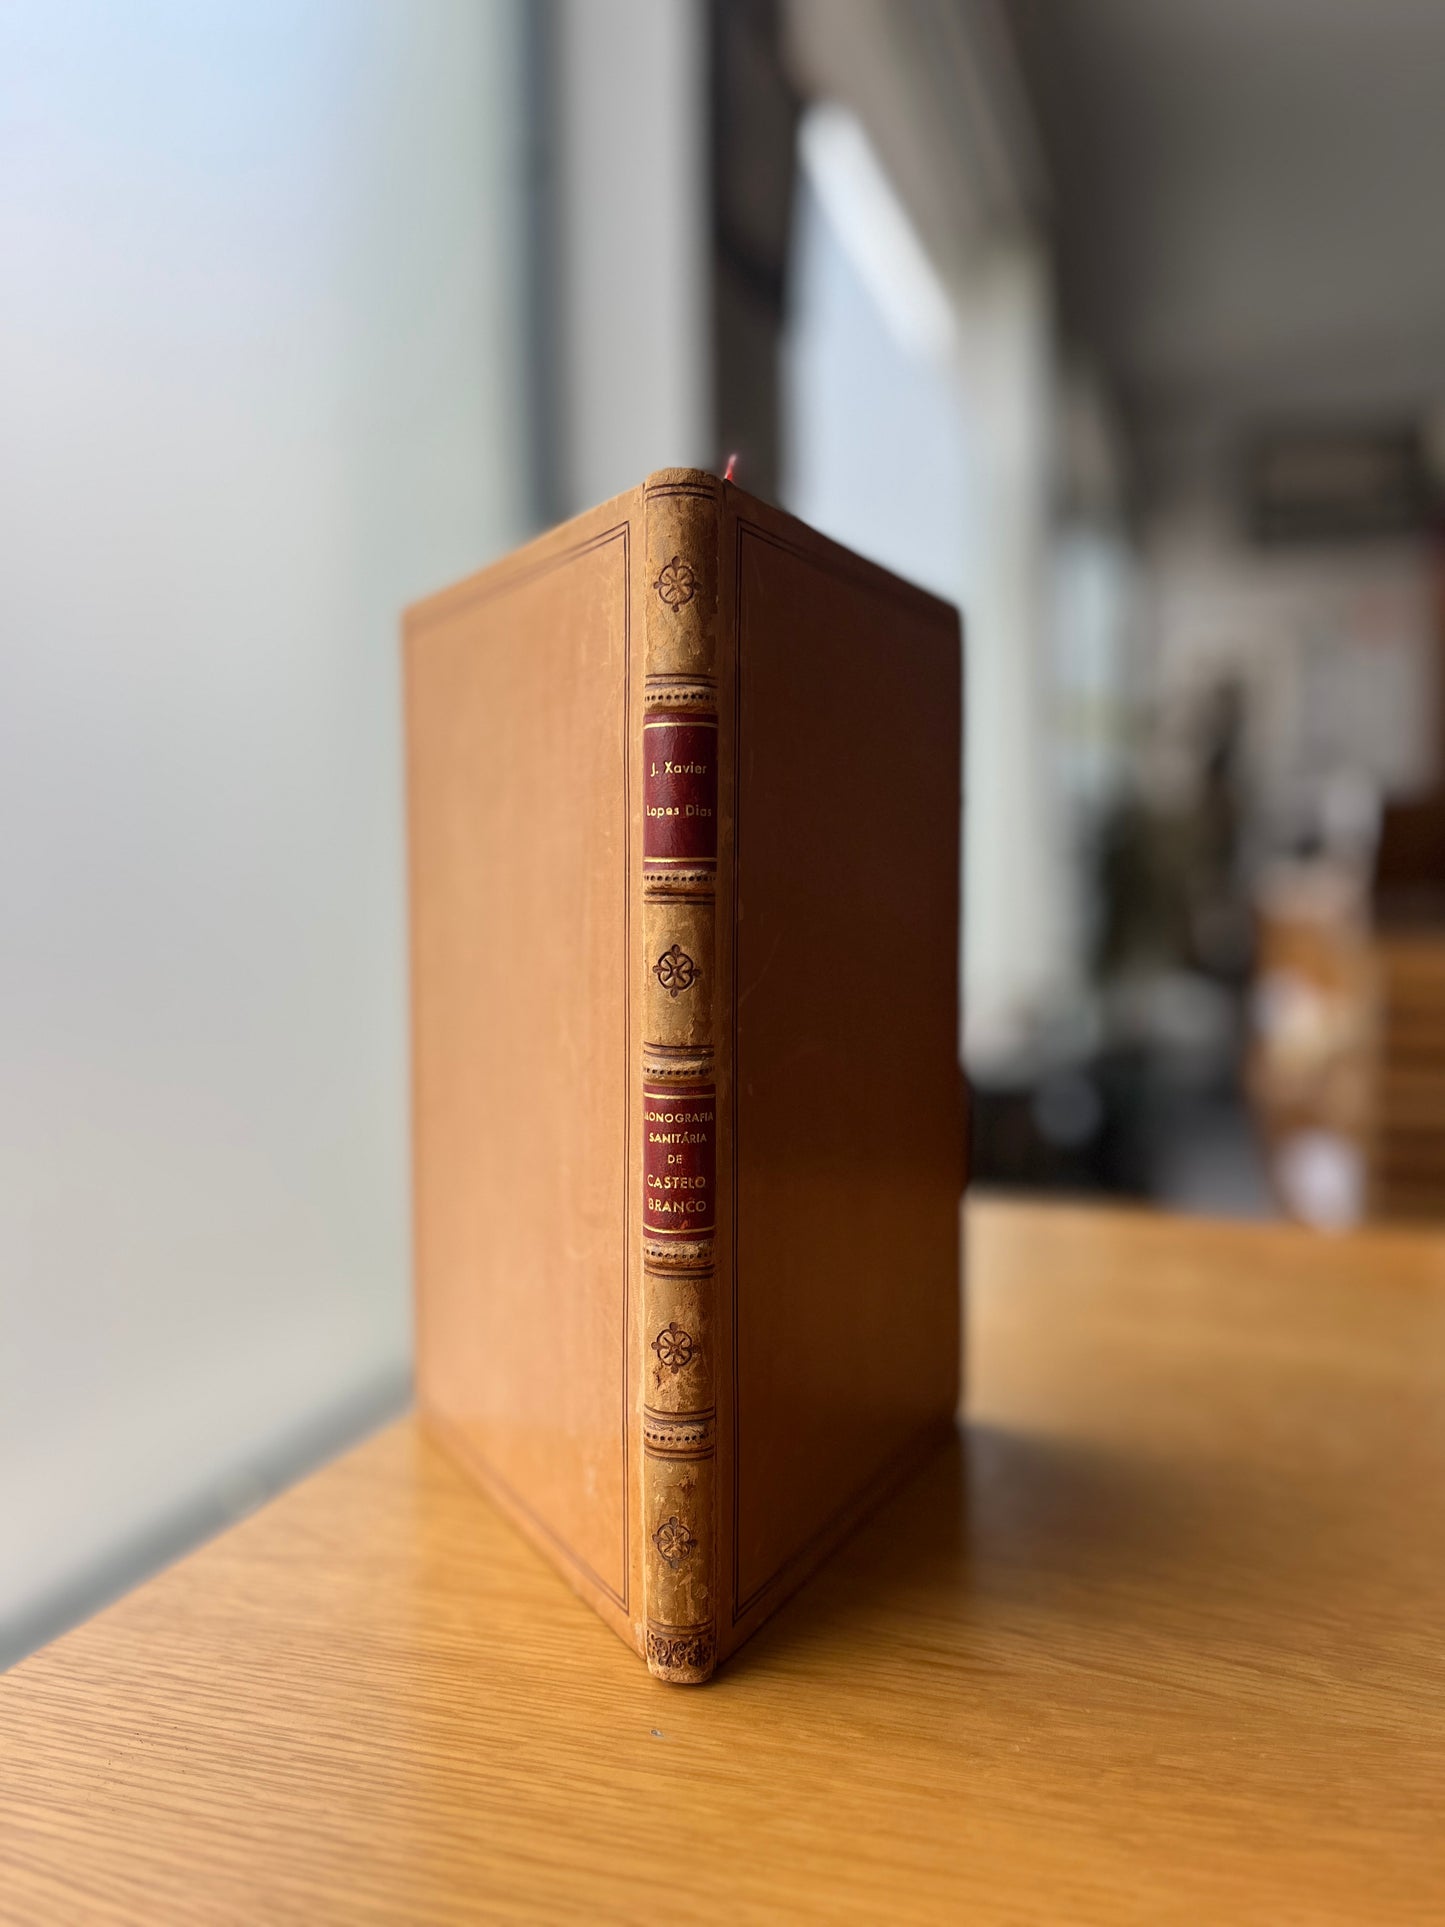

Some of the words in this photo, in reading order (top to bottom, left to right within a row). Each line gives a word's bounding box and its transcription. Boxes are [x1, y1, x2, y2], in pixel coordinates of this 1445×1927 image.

[650, 762, 659, 777] J.
[664, 761, 707, 774] Xavier
[646, 804, 680, 818] Lopes
[685, 804, 712, 817] Dias
[649, 1131, 707, 1144] SANITÁRIA
[667, 1154, 682, 1164] DE
[647, 1174, 706, 1189] CASTELO
[648, 1198, 707, 1213] BRANCO
